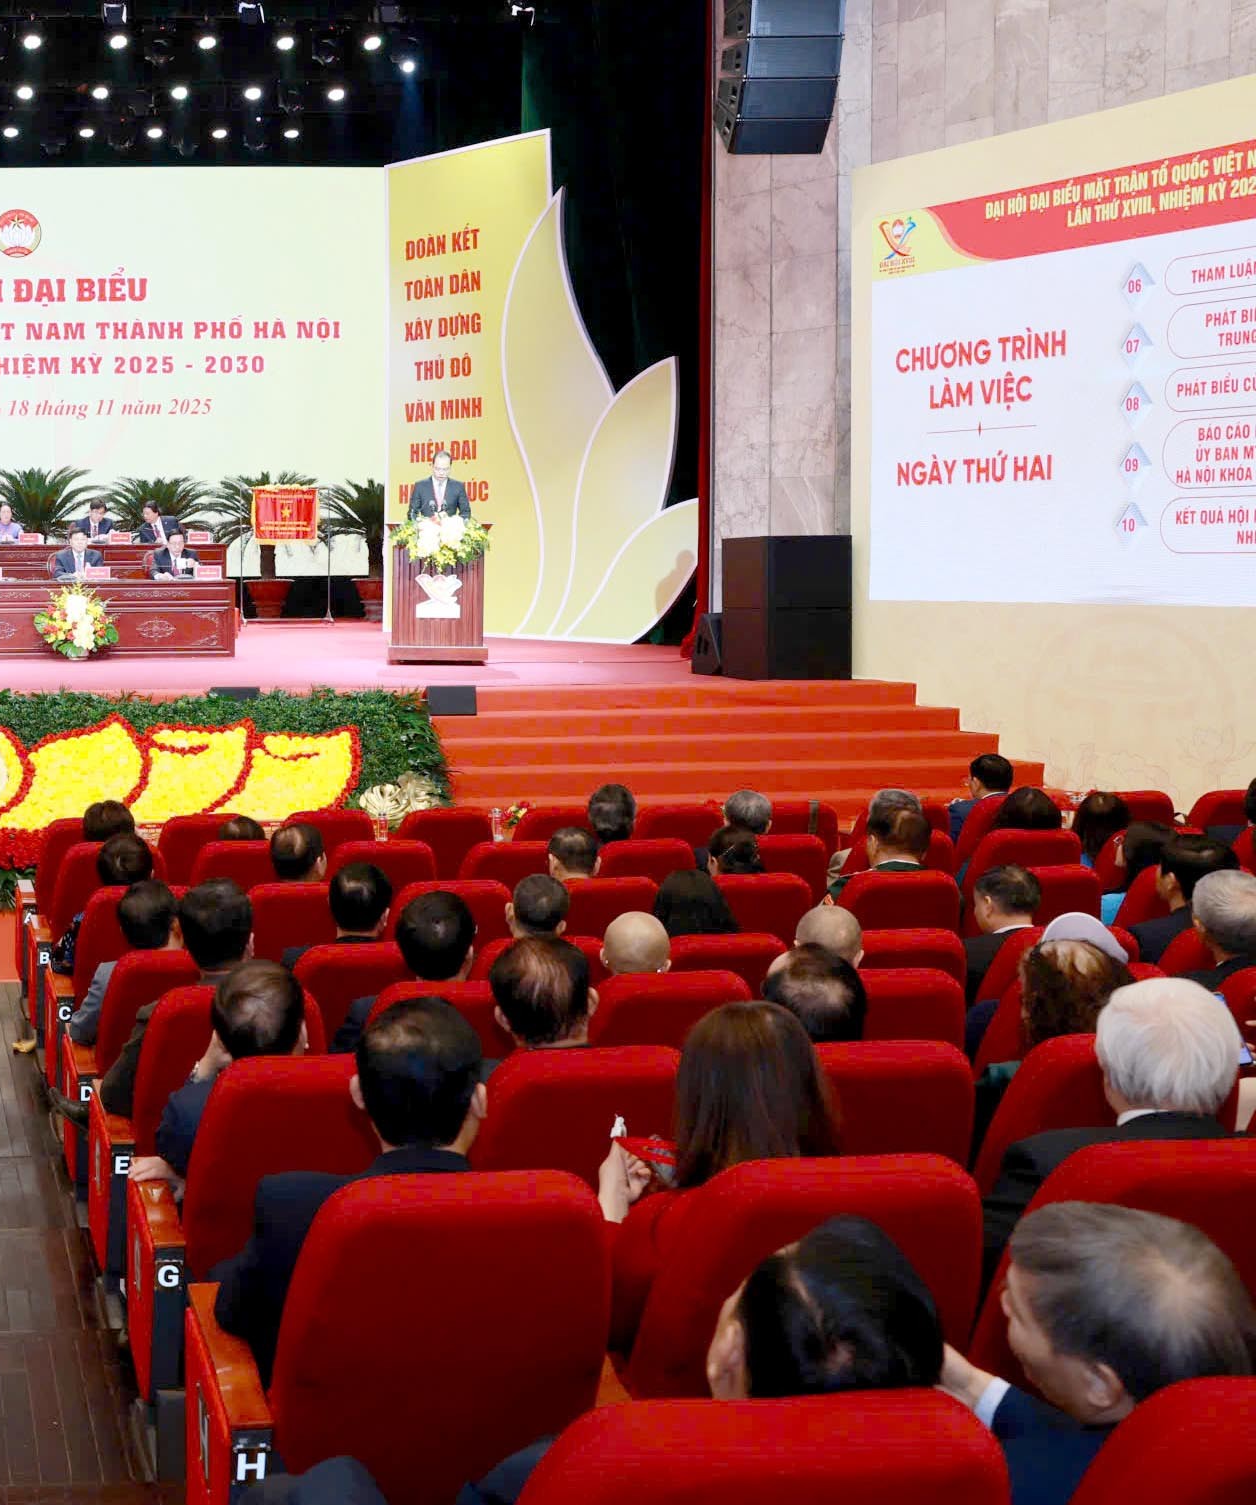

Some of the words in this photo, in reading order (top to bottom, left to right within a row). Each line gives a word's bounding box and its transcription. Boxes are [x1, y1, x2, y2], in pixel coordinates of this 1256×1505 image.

[985, 200, 1005, 221] ĐẠI
[1007, 193, 1027, 217] HỘI
[1029, 191, 1050, 213] ĐẠI
[1052, 179, 1081, 207] BIỂU
[1083, 177, 1111, 202] MẶT
[1114, 170, 1148, 195] TRẬN
[1151, 160, 1168, 188] TỔ
[1172, 154, 1209, 185] QUỐC
[1213, 150, 1243, 177] VIỆT
[1094, 197, 1120, 223] THỨ
[1159, 184, 1204, 211] NHIỆM
[1208, 178, 1226, 202] KỲ
[405, 232, 447, 261] ĐOÀN
[451, 222, 481, 253] KẾT
[13, 278, 66, 307] ĐẠI
[76, 266, 148, 302] BIỂU
[404, 275, 444, 301] TOÀN
[449, 269, 481, 296] DÂN
[1128, 279, 1142, 294] 06
[1192, 266, 1225, 284] THAM
[26, 322, 85, 340] NAM
[96, 317, 183, 340] THÀNH
[194, 314, 243, 339] PHỐ
[253, 317, 287, 339] HÀ
[296, 317, 340, 342] NỘI
[404, 317, 433, 342] XÂY
[438, 312, 482, 340] DỰNG
[1205, 307, 1237, 328] PHÁT
[895, 338, 992, 374] CHƯƠNG
[997, 327, 1067, 362] TRÌNH
[1126, 339, 1140, 354] 07
[71, 352, 103, 375] KỲ
[114, 356, 174, 374] 2025
[204, 355, 265, 374] 2030
[414, 354, 444, 382] THỦ
[450, 352, 472, 378] ĐÔ
[929, 377, 973, 410] LÀM
[981, 371, 1033, 412] VIỆC
[1177, 378, 1207, 397] PHÁT
[1211, 372, 1239, 394] BIỂU
[8, 400, 29, 416] 18
[35, 399, 88, 420] tháng
[95, 399, 115, 416] 11
[122, 400, 162, 415] năm
[168, 398, 213, 415] 2025
[404, 399, 435, 423] VĂN
[440, 397, 482, 420] MINH
[1126, 396, 1140, 411] 08
[1198, 424, 1221, 441] BÁO
[1226, 421, 1250, 440] CÁO
[450, 439, 477, 464] ĐẠI
[1215, 446, 1239, 461] BAN
[896, 453, 957, 487] NGÀY
[963, 449, 1008, 484] THỨ
[1013, 454, 1053, 482] HAI
[1125, 458, 1139, 472] 09
[1176, 466, 1191, 483] HÀ
[1195, 465, 1215, 485] NỘI
[1122, 518, 1135, 532] 10
[1176, 506, 1197, 525] KẾT
[1228, 505, 1249, 527] HỘI
[40, 952, 50, 964] B
[59, 1006, 72, 1020] C
[80, 1086, 93, 1102] D
[114, 1156, 130, 1175] E
[157, 1265, 179, 1288] G
[236, 1453, 266, 1481] H
